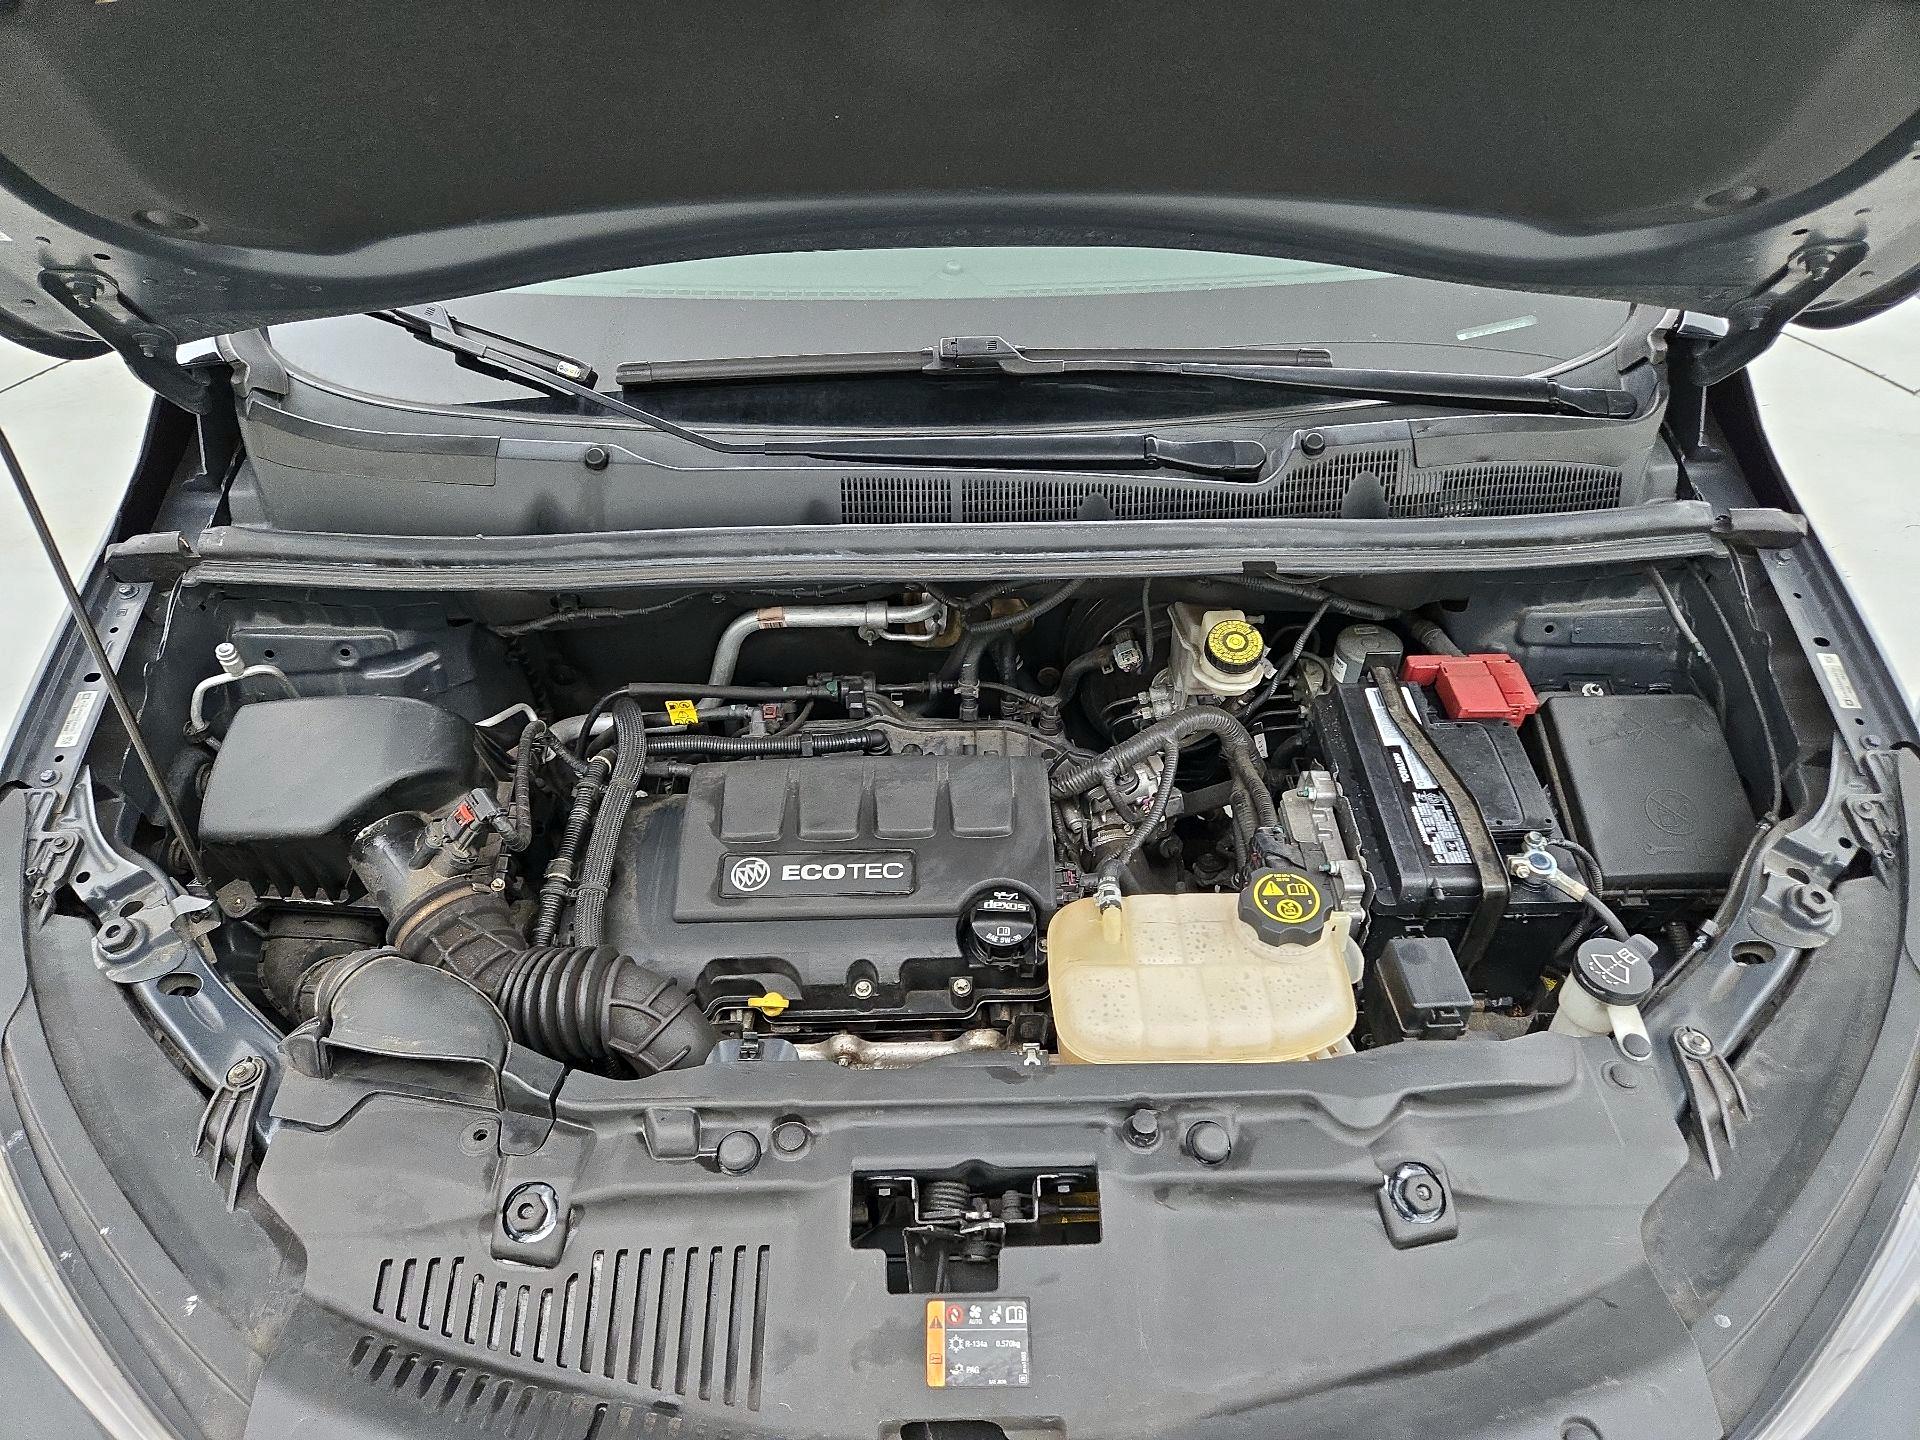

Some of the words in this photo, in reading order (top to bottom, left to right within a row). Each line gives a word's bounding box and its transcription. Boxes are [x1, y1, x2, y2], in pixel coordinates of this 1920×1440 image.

[781, 862, 904, 881] ECOTEC
[965, 1340, 988, 1348] R-134a
[966, 1366, 980, 1374] PAG
